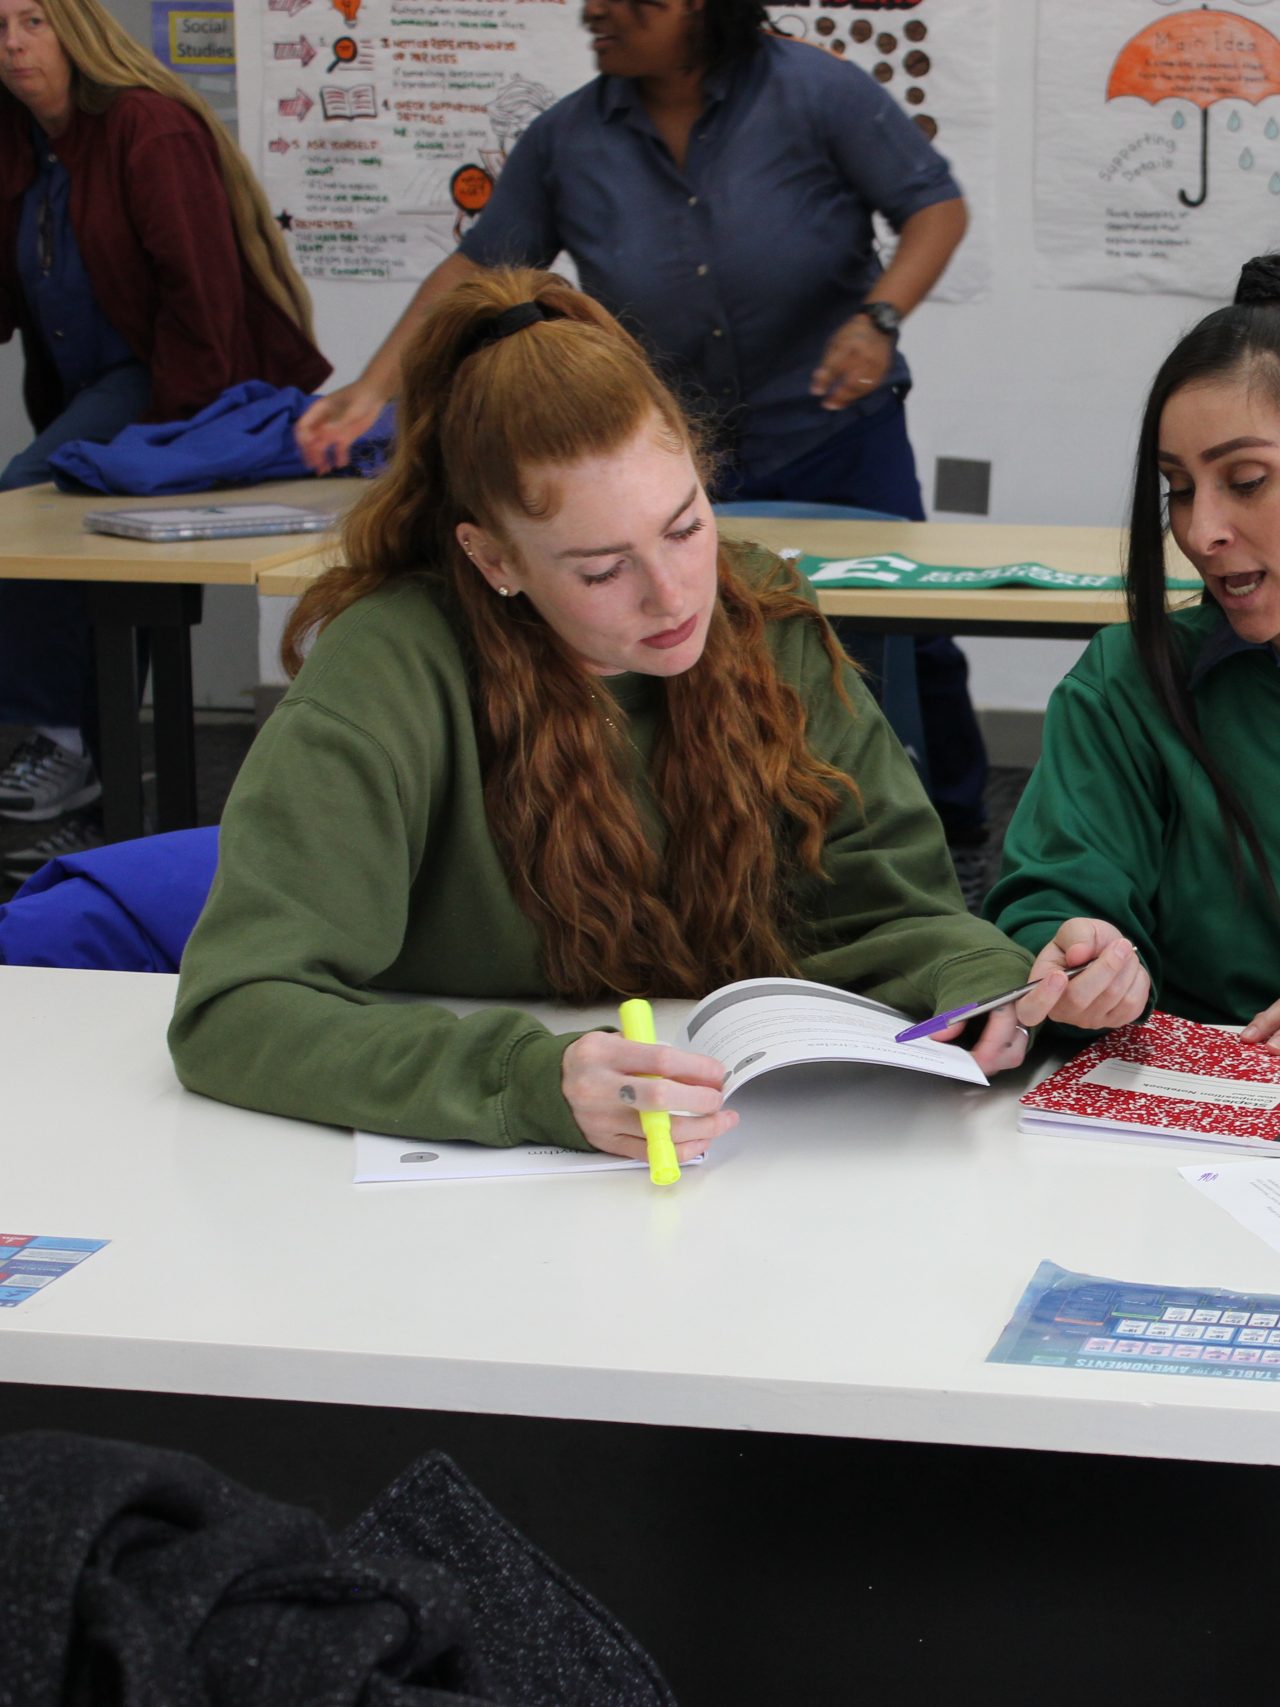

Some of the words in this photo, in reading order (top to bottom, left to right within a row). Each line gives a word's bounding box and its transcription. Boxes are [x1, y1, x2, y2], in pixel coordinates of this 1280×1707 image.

[182, 18, 227, 33] Social
[1154, 31, 1204, 53] Main
[1213, 30, 1258, 52] Idea
[177, 43, 234, 58] Studies
[1098, 132, 1178, 182] Supporting
[1121, 156, 1175, 183] Details
[1142, 1082, 1197, 1095] Notebook
[1199, 1091, 1273, 1104] Composition
[1213, 1098, 1268, 1108] Staples
[1074, 1357, 1190, 1374] AMENDMENTS
[1224, 1367, 1272, 1381] TABLE
